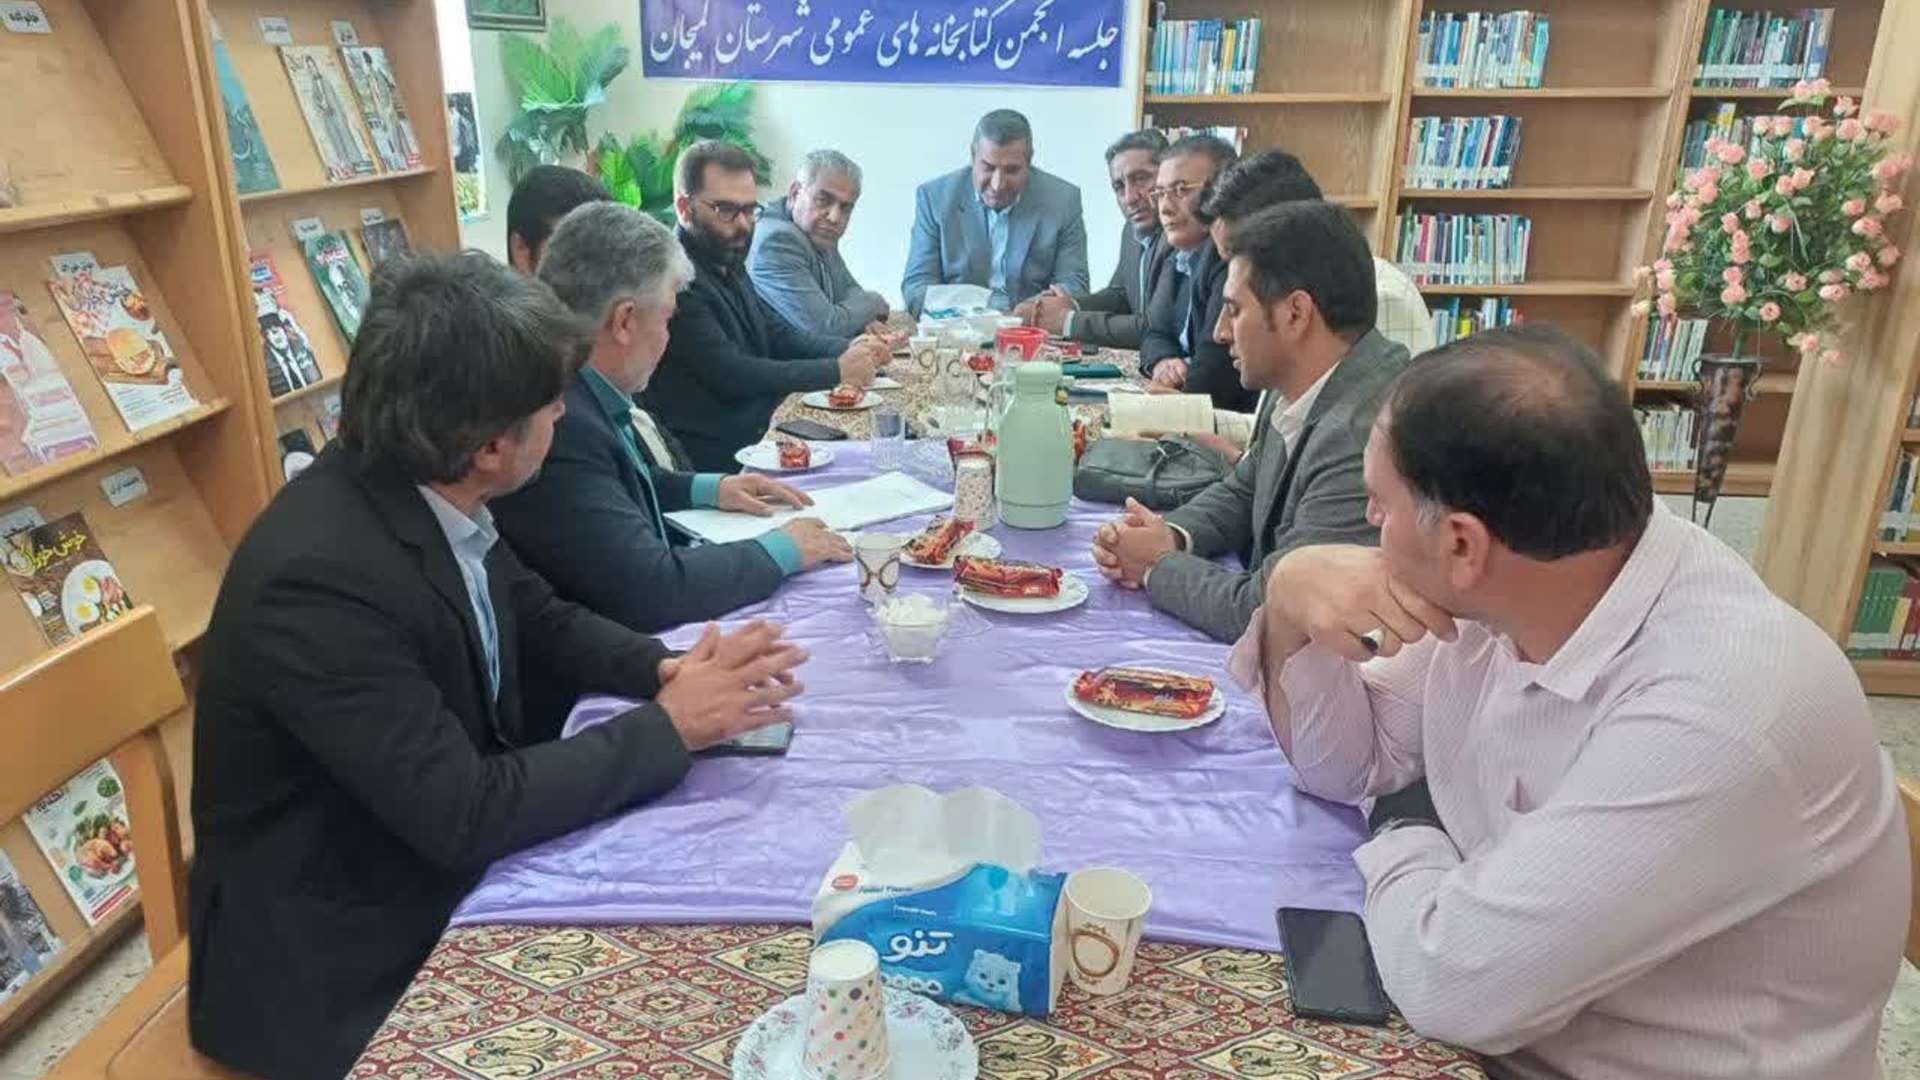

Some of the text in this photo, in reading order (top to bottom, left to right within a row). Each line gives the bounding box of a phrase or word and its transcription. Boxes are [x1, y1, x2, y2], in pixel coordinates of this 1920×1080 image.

[715, 0, 811, 64] شهرستان
[809, 9, 875, 65] عمومی
[877, 10, 920, 67] های
[924, 0, 1016, 61] کتابخانه
[994, 0, 1064, 70] انجمن
[1067, 19, 1119, 70] جلسه
[880, 930, 955, 962] تنو
